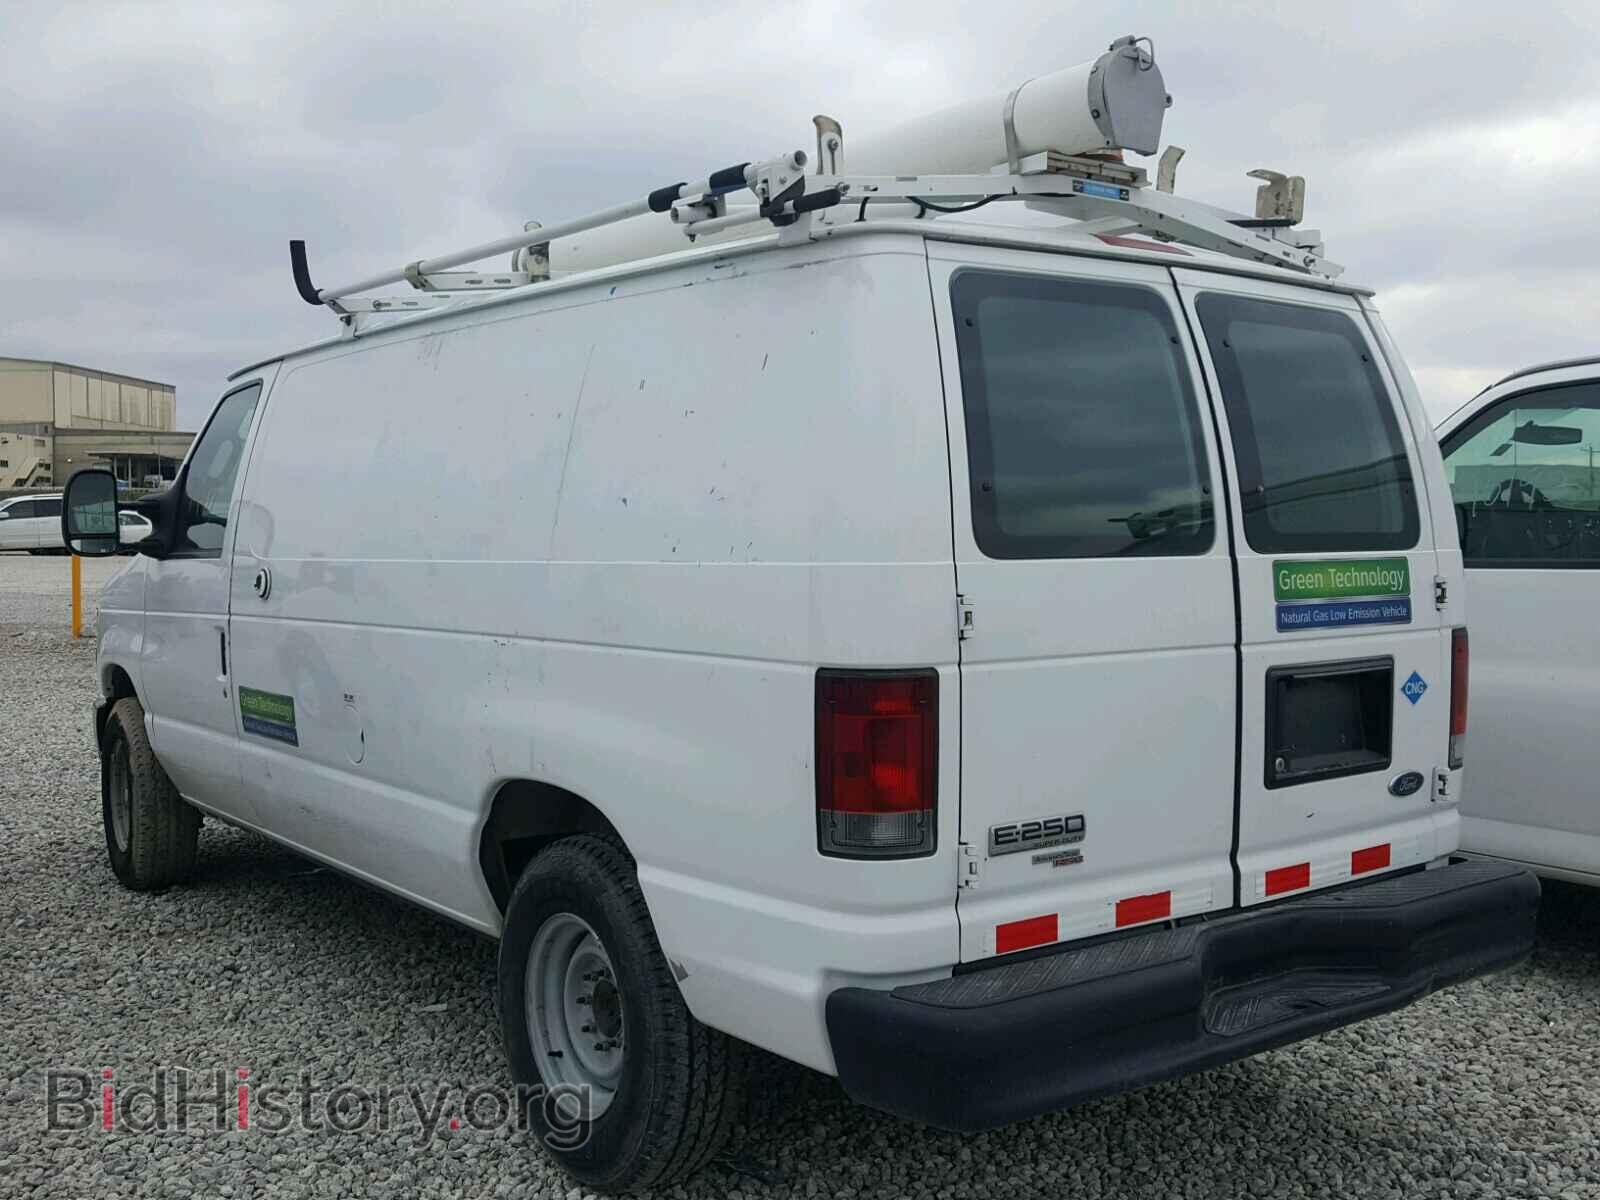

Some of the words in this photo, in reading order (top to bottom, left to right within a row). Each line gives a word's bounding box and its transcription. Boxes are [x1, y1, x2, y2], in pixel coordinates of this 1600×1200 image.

[1279, 569, 1324, 591] Green
[1327, 565, 1405, 591] Technology
[1281, 609, 1311, 624] Natural
[1312, 608, 1329, 622] Gas
[1330, 608, 1346, 621] Low
[1348, 606, 1380, 620] Emission
[1382, 604, 1408, 617] Vehicle
[1404, 682, 1425, 695] CNG
[1398, 776, 1418, 793] Ford
[994, 814, 1085, 846] E-250
